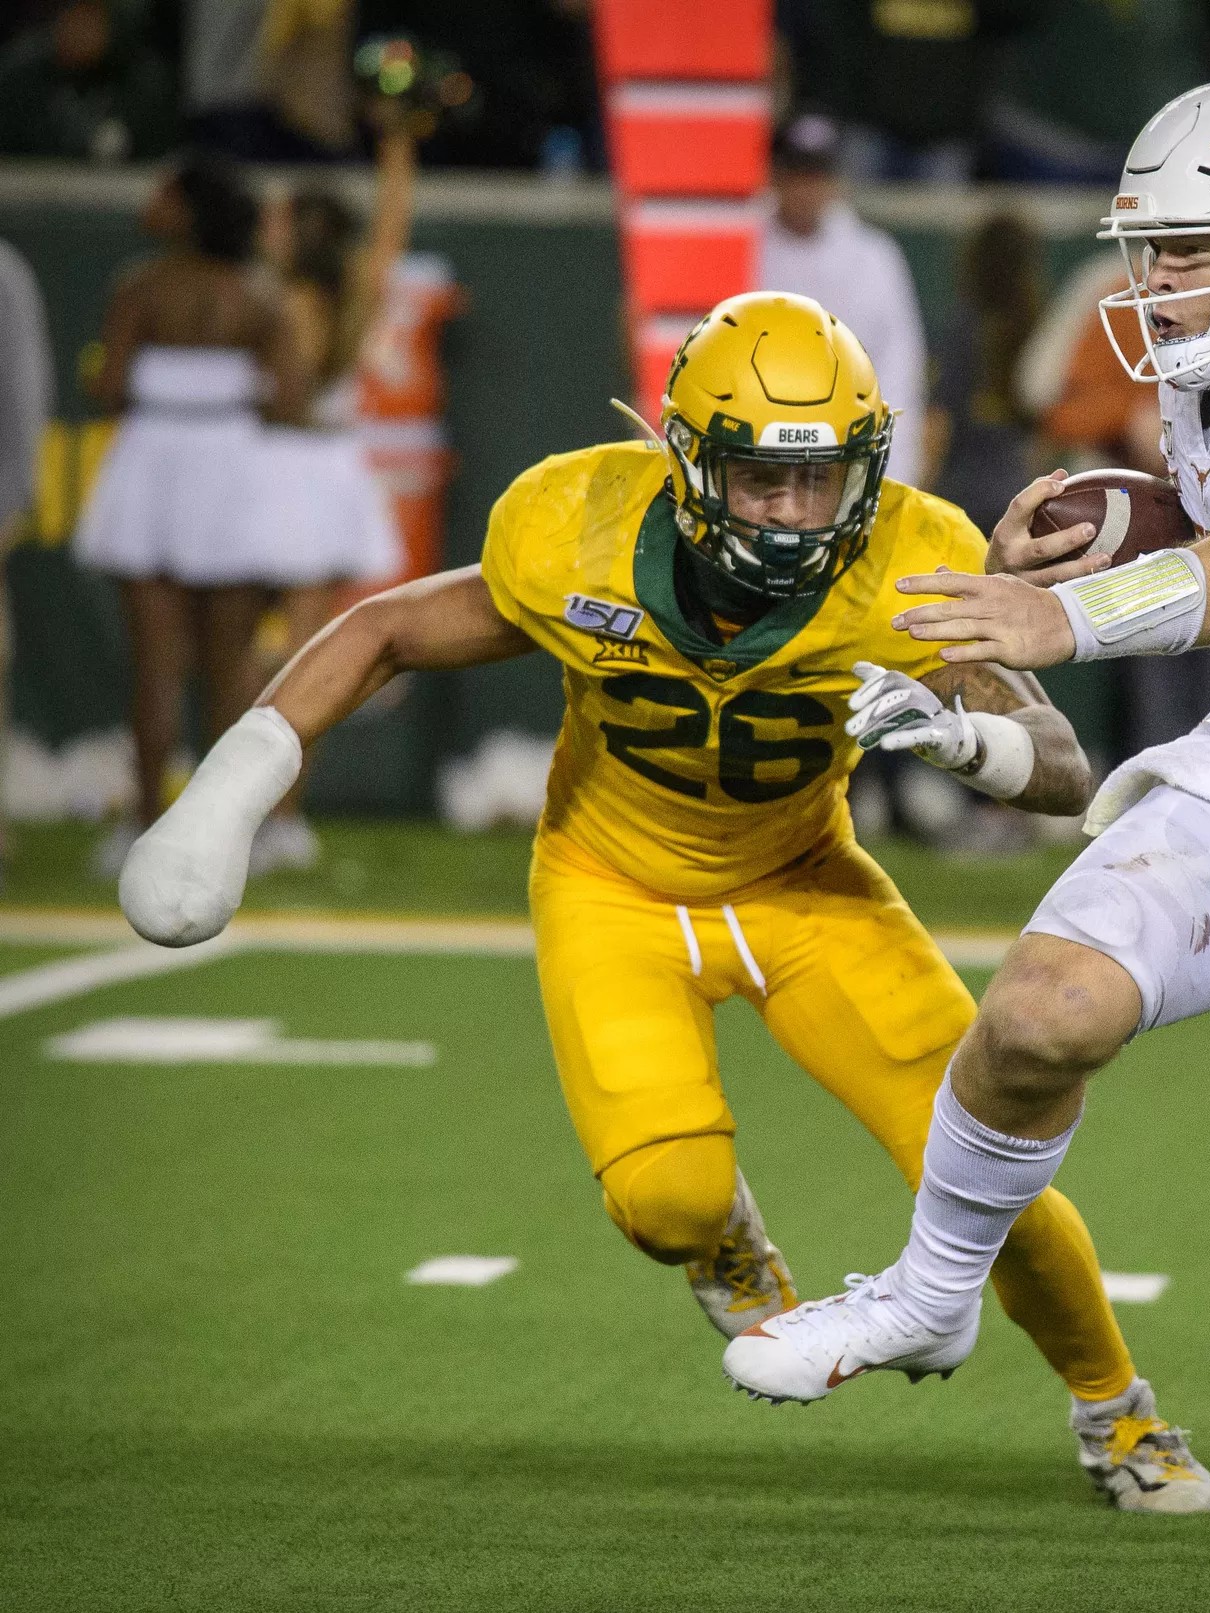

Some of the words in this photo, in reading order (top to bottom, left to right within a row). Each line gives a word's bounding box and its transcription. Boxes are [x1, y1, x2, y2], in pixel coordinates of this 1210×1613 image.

[1116, 196, 1139, 210] HORNS
[721, 418, 741, 433] NIKE
[778, 428, 819, 444] BEARS
[564, 594, 642, 638] 150
[592, 637, 650, 667] XII
[600, 672, 834, 804] 26
